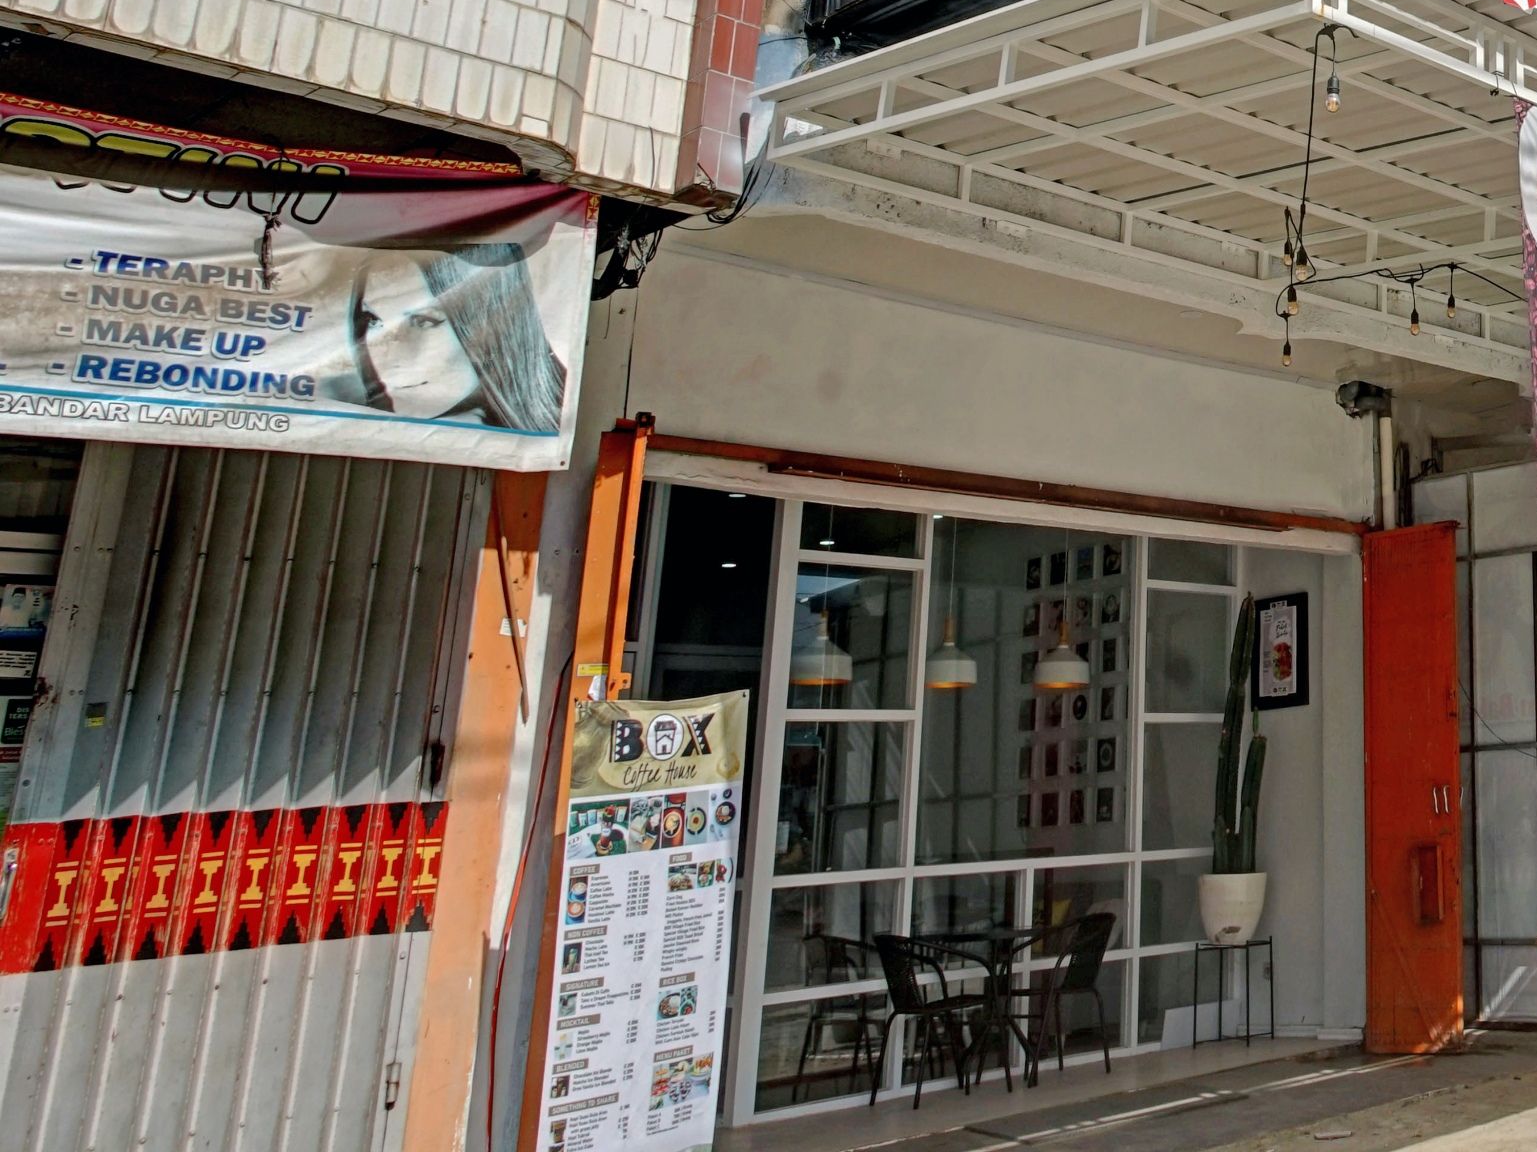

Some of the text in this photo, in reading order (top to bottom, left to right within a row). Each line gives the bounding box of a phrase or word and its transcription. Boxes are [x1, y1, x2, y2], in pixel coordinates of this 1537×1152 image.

[89, 284, 312, 328] NUGA BEST
[85, 319, 266, 357] MAKE UP
[76, 354, 316, 397] REBONDING
[138, 405, 290, 432] LAMPUNG
[609, 712, 716, 763] BOX
[623, 760, 698, 792] Coffee House
[573, 865, 596, 874] COFFEE
[582, 928, 604, 937] COFFEE
[560, 1017, 591, 1028] MOCKTAIL
[556, 1061, 585, 1073] BLENDED
[551, 1102, 587, 1114] SOMETHING
